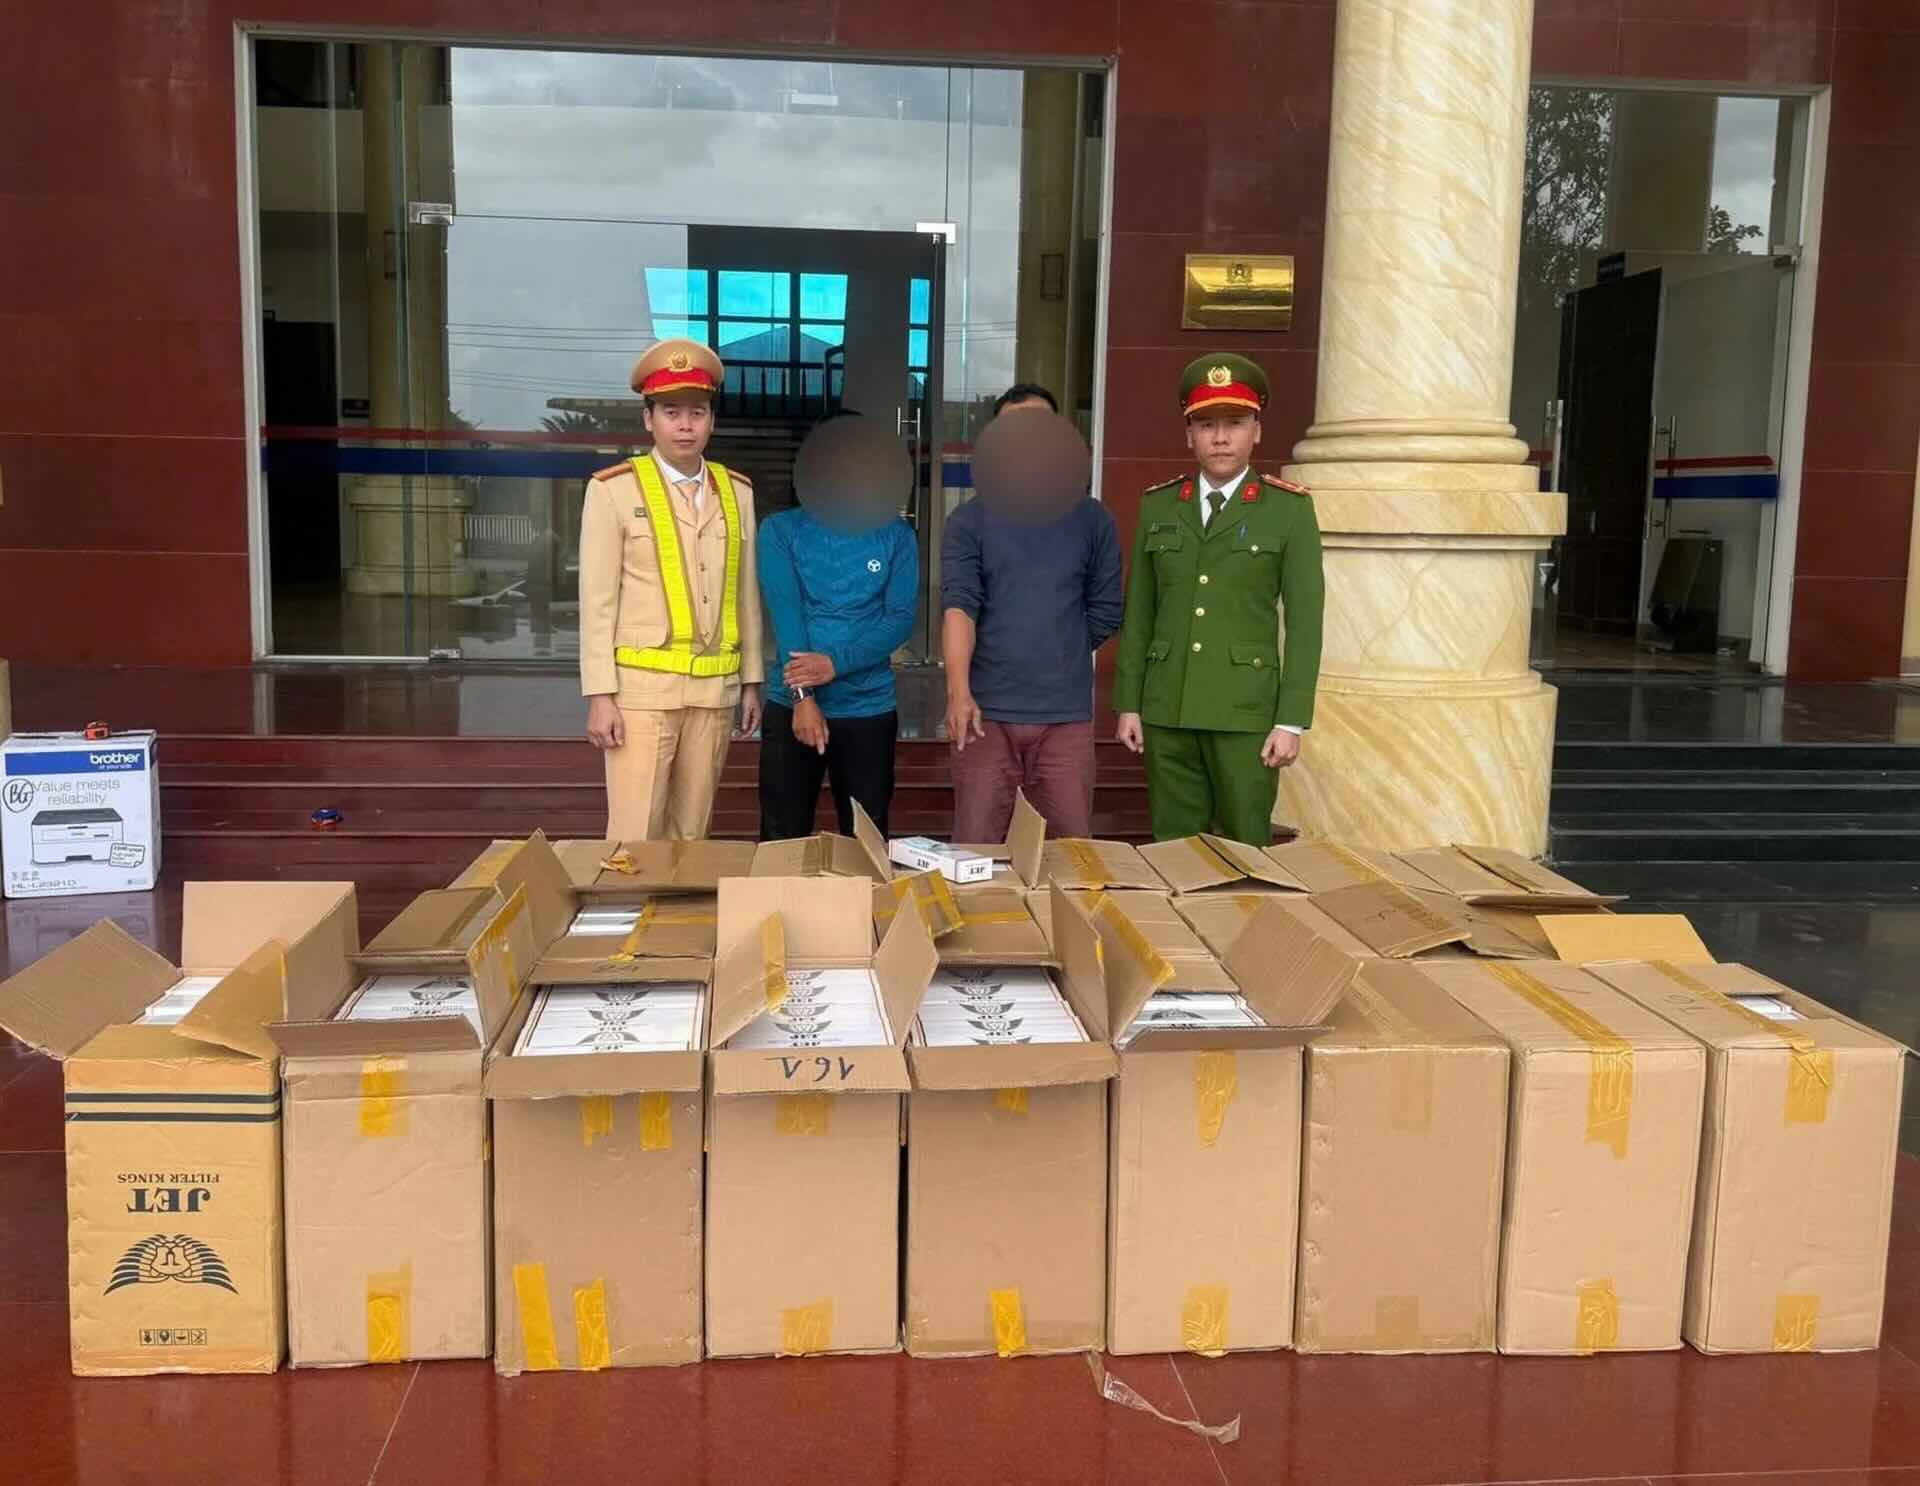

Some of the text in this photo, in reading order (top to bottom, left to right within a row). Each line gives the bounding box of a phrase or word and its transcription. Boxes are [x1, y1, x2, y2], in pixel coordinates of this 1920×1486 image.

[90, 752, 140, 765] brother
[33, 778, 120, 793] Value meets
[47, 791, 107, 806] reliability
[117, 1173, 220, 1184] FILTER KINGS
[126, 1187, 211, 1213] JET
